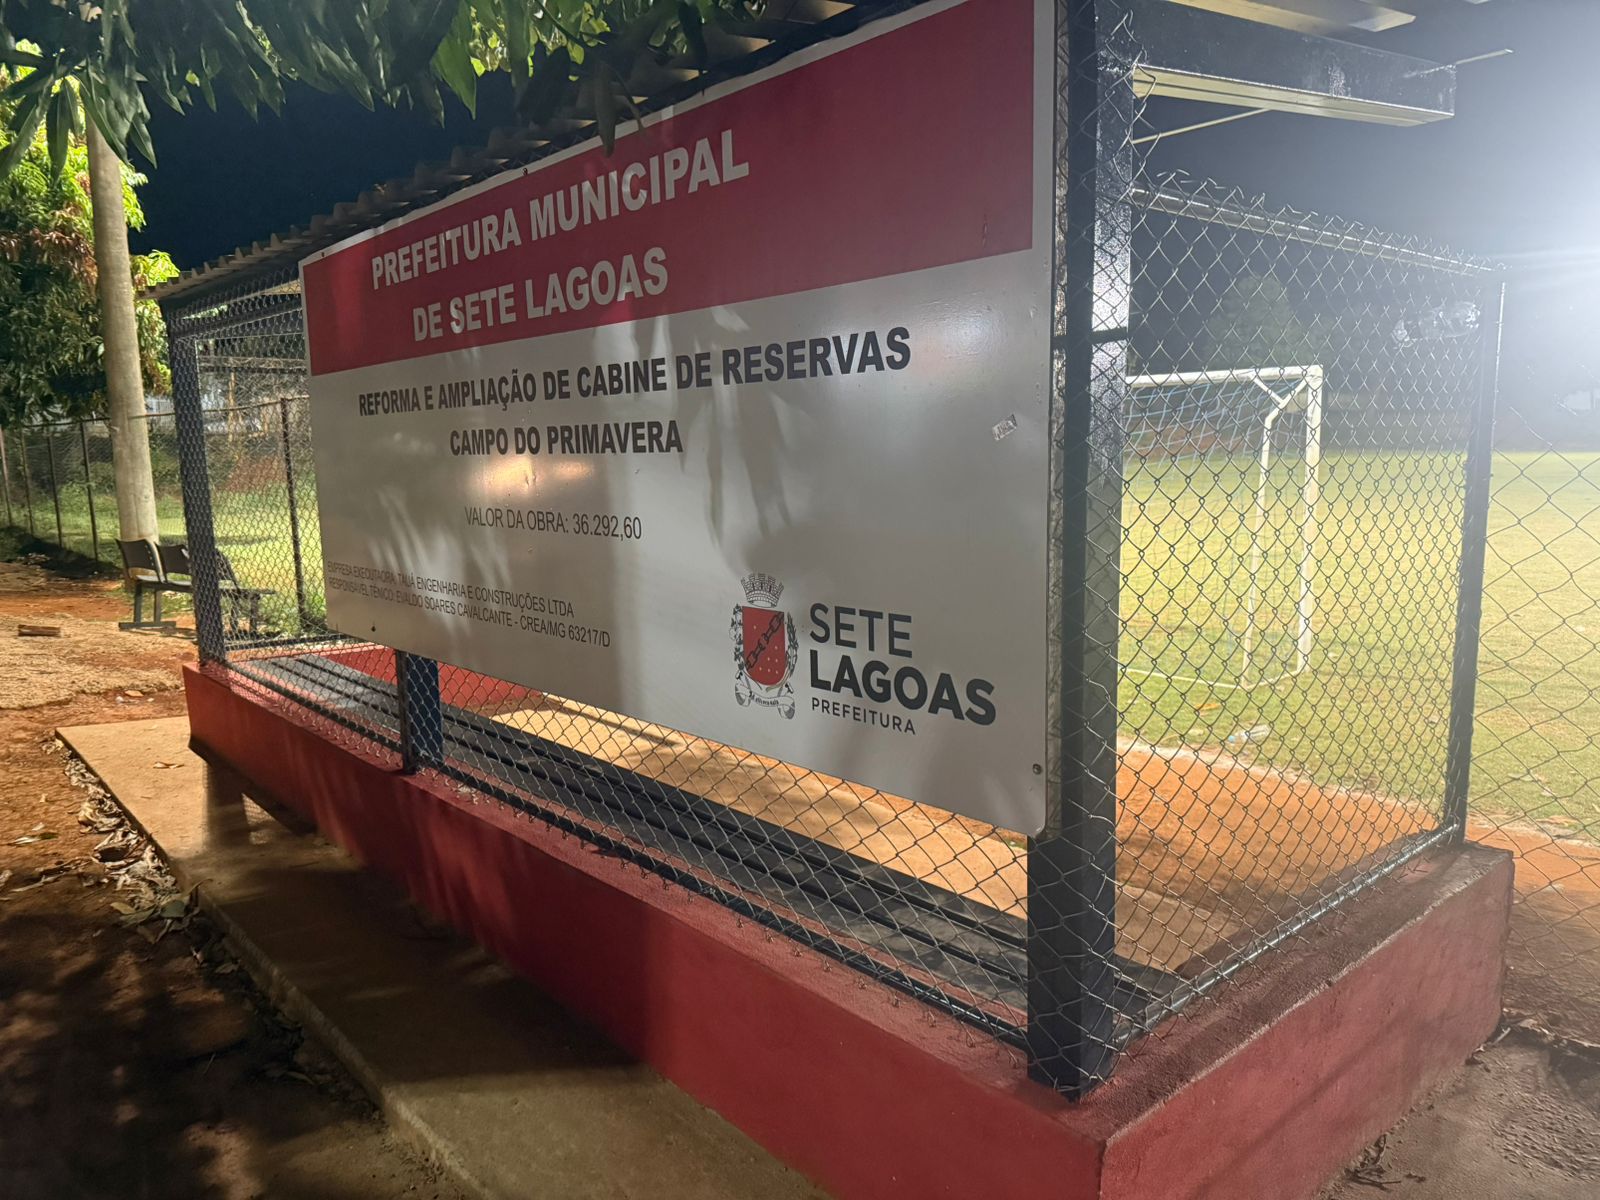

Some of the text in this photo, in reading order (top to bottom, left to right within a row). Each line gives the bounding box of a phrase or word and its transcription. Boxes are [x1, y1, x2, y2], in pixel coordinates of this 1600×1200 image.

[371, 129, 750, 290] PREFEITURA MUNICIPAL
[412, 247, 669, 342] DE SETE LAGOAS
[359, 326, 911, 416] REFORMA E AMPLIAÇÃO DE CABINE DE RESERVAS
[450, 420, 683, 456] CAMPO DO PRIMAVERA
[464, 506, 642, 541] VALOR DA OBRA: 36.292,60
[417, 576, 467, 597] ENGENHARIA
[468, 585, 473, 599] E
[475, 586, 546, 613] CONSTRUÇÕES
[548, 599, 574, 618] LTDA
[424, 595, 456, 615] SOARES
[457, 602, 513, 627] CAVALCANTE
[520, 615, 566, 638] CREA/MG
[568, 625, 610, 648] 63217/D
[809, 602, 912, 658] SETE
[810, 649, 996, 726] LAGOAS
[811, 697, 916, 735] PREFEITURA
